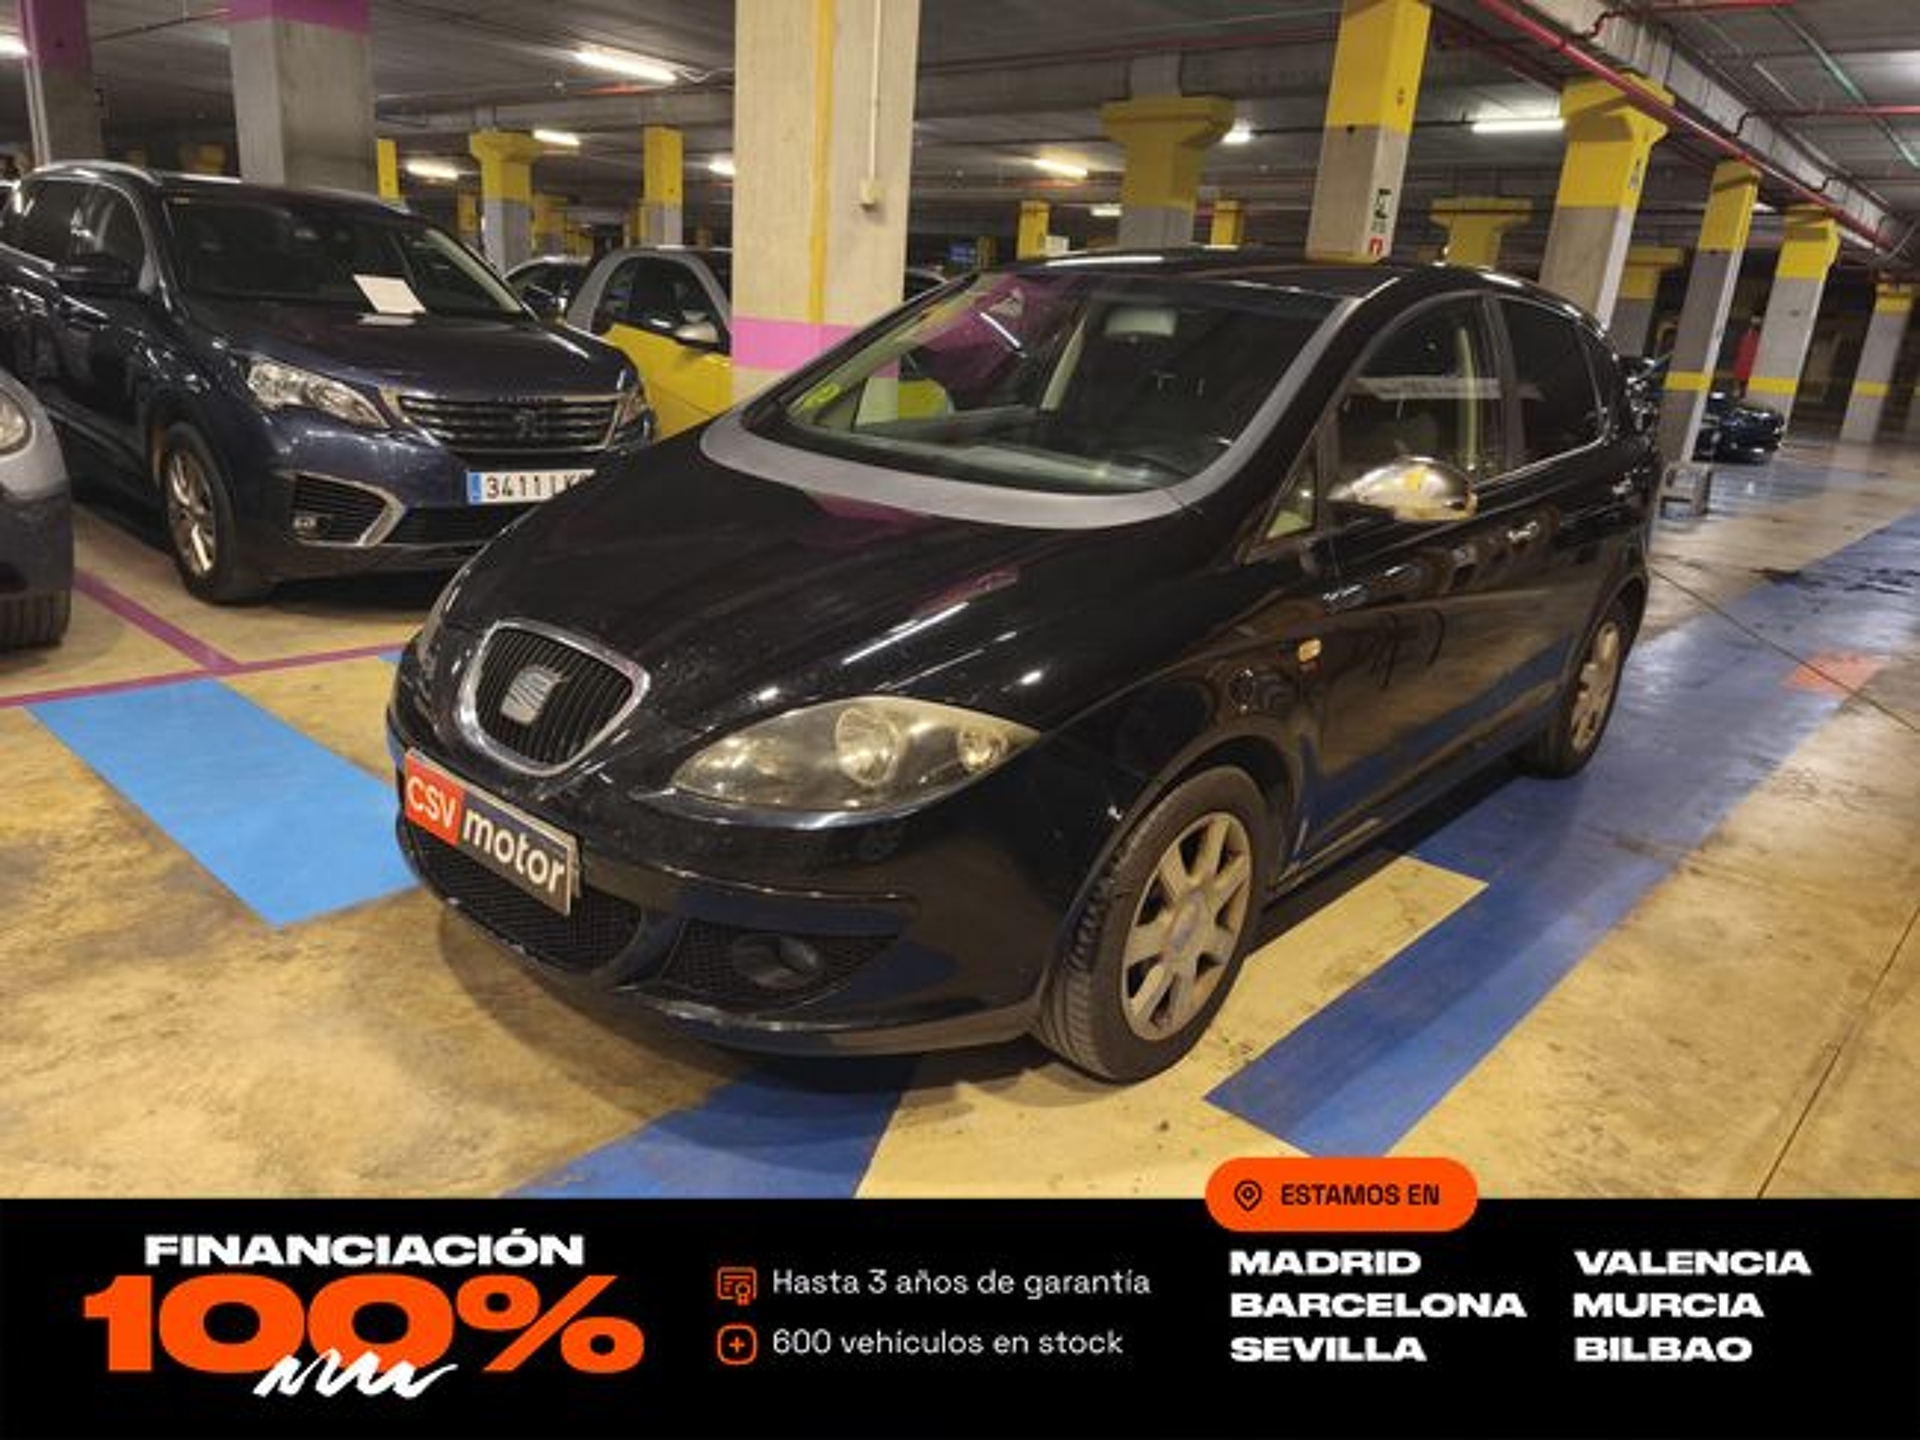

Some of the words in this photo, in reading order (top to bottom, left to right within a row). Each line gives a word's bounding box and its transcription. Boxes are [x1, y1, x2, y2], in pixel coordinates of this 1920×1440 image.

[486, 474, 541, 499] 3411
[406, 775, 457, 829] CSV
[462, 808, 566, 893] motor
